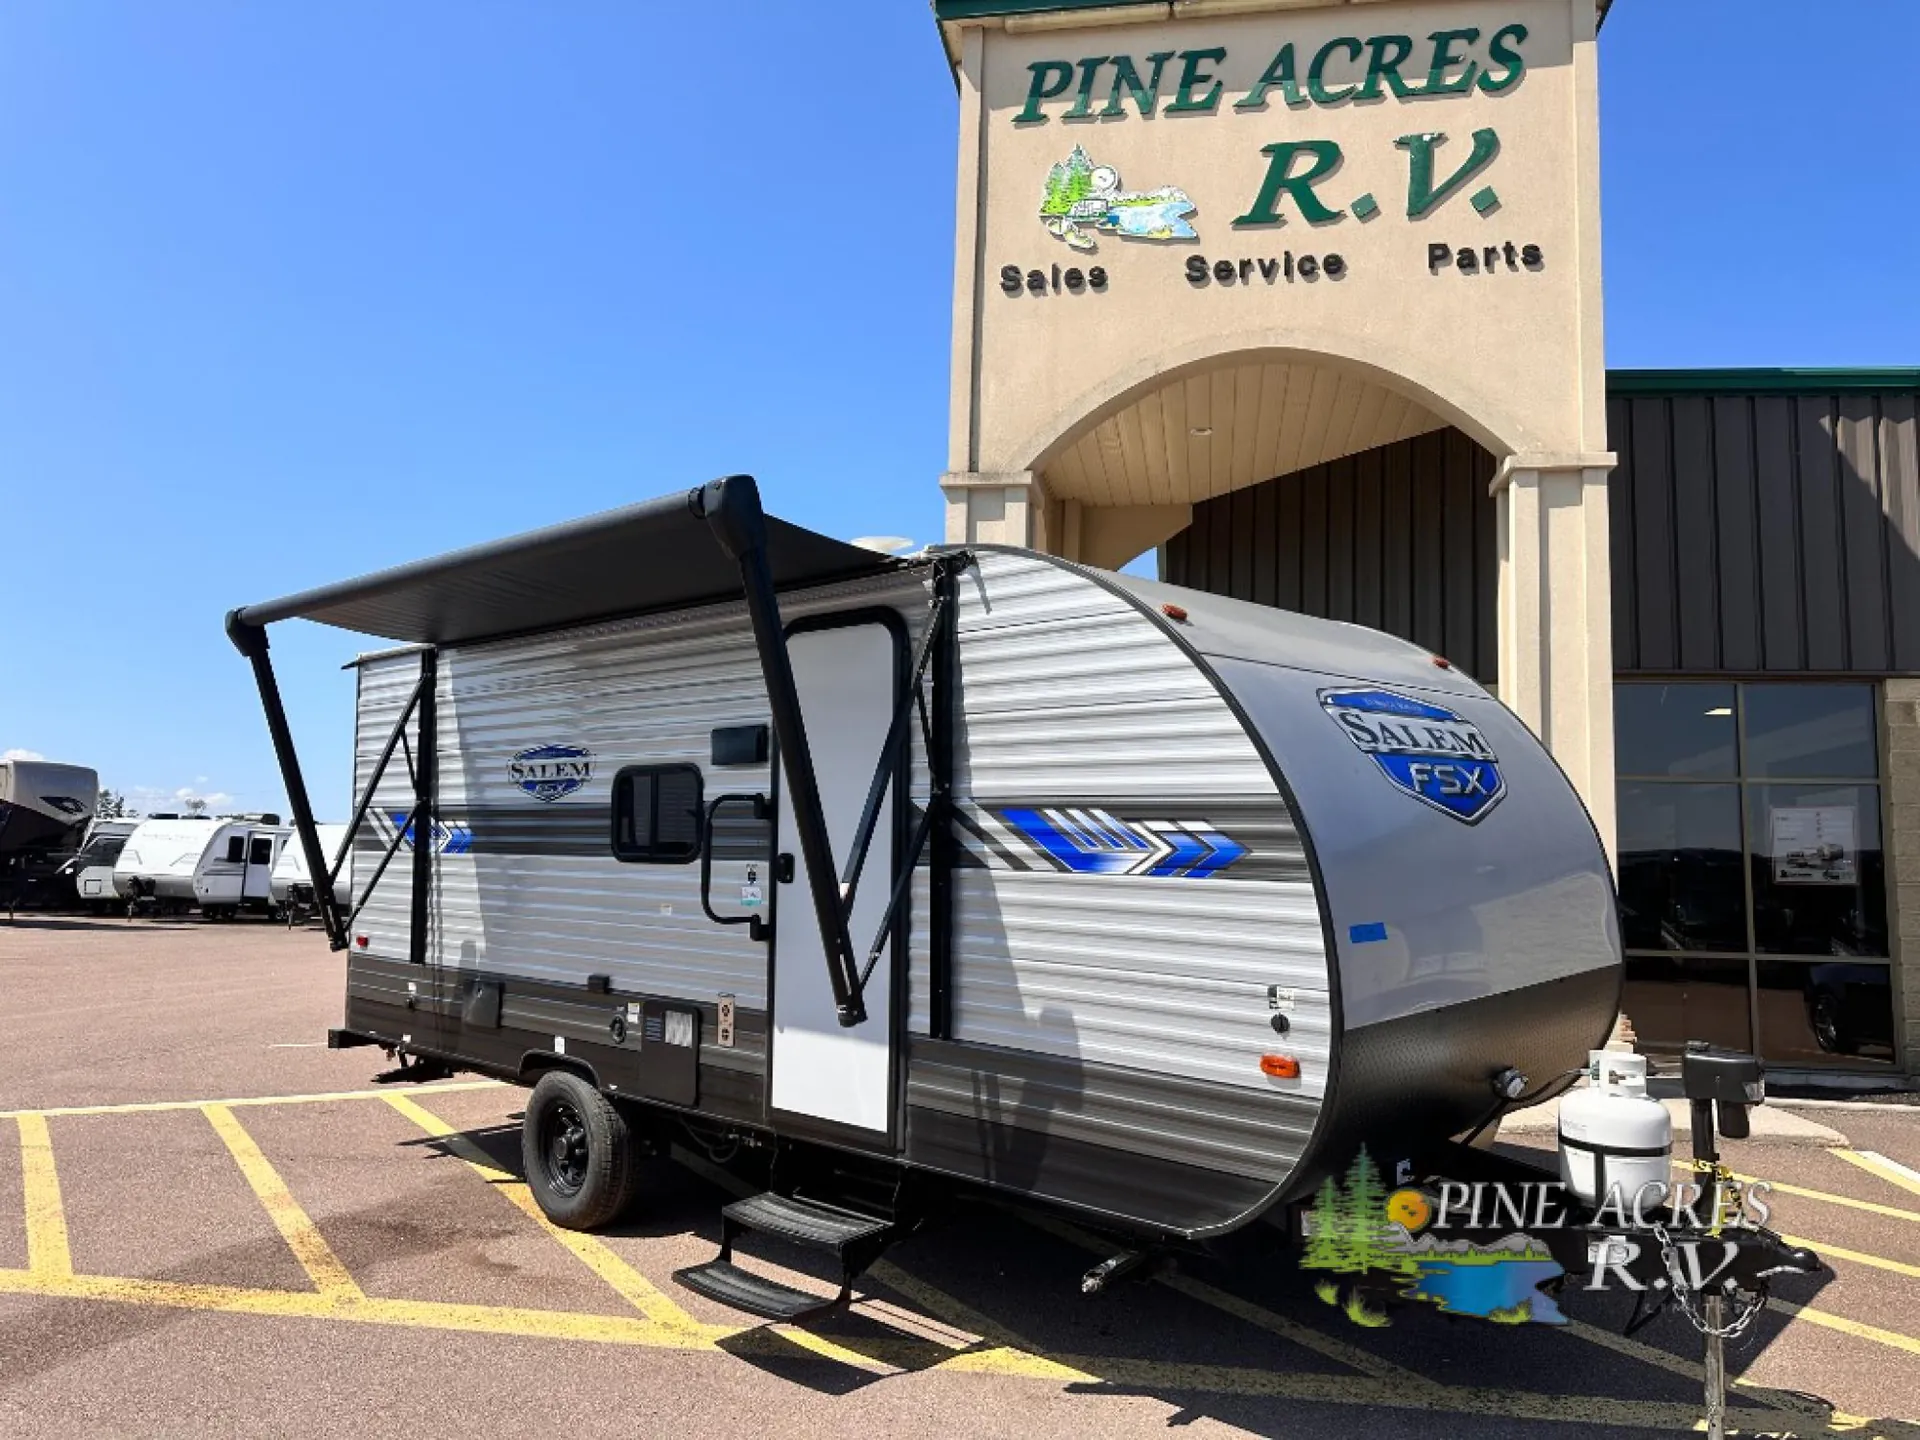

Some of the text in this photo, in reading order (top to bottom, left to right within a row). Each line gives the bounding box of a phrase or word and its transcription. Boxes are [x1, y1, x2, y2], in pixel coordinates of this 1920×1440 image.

[1012, 23, 1529, 123] PINE ACRES
[1231, 127, 1502, 226] R.V.
[1000, 241, 1544, 296] Sales Service Parts
[1339, 712, 1491, 755] SALEM
[511, 762, 590, 779] SALEM
[1408, 762, 1489, 795] FSX
